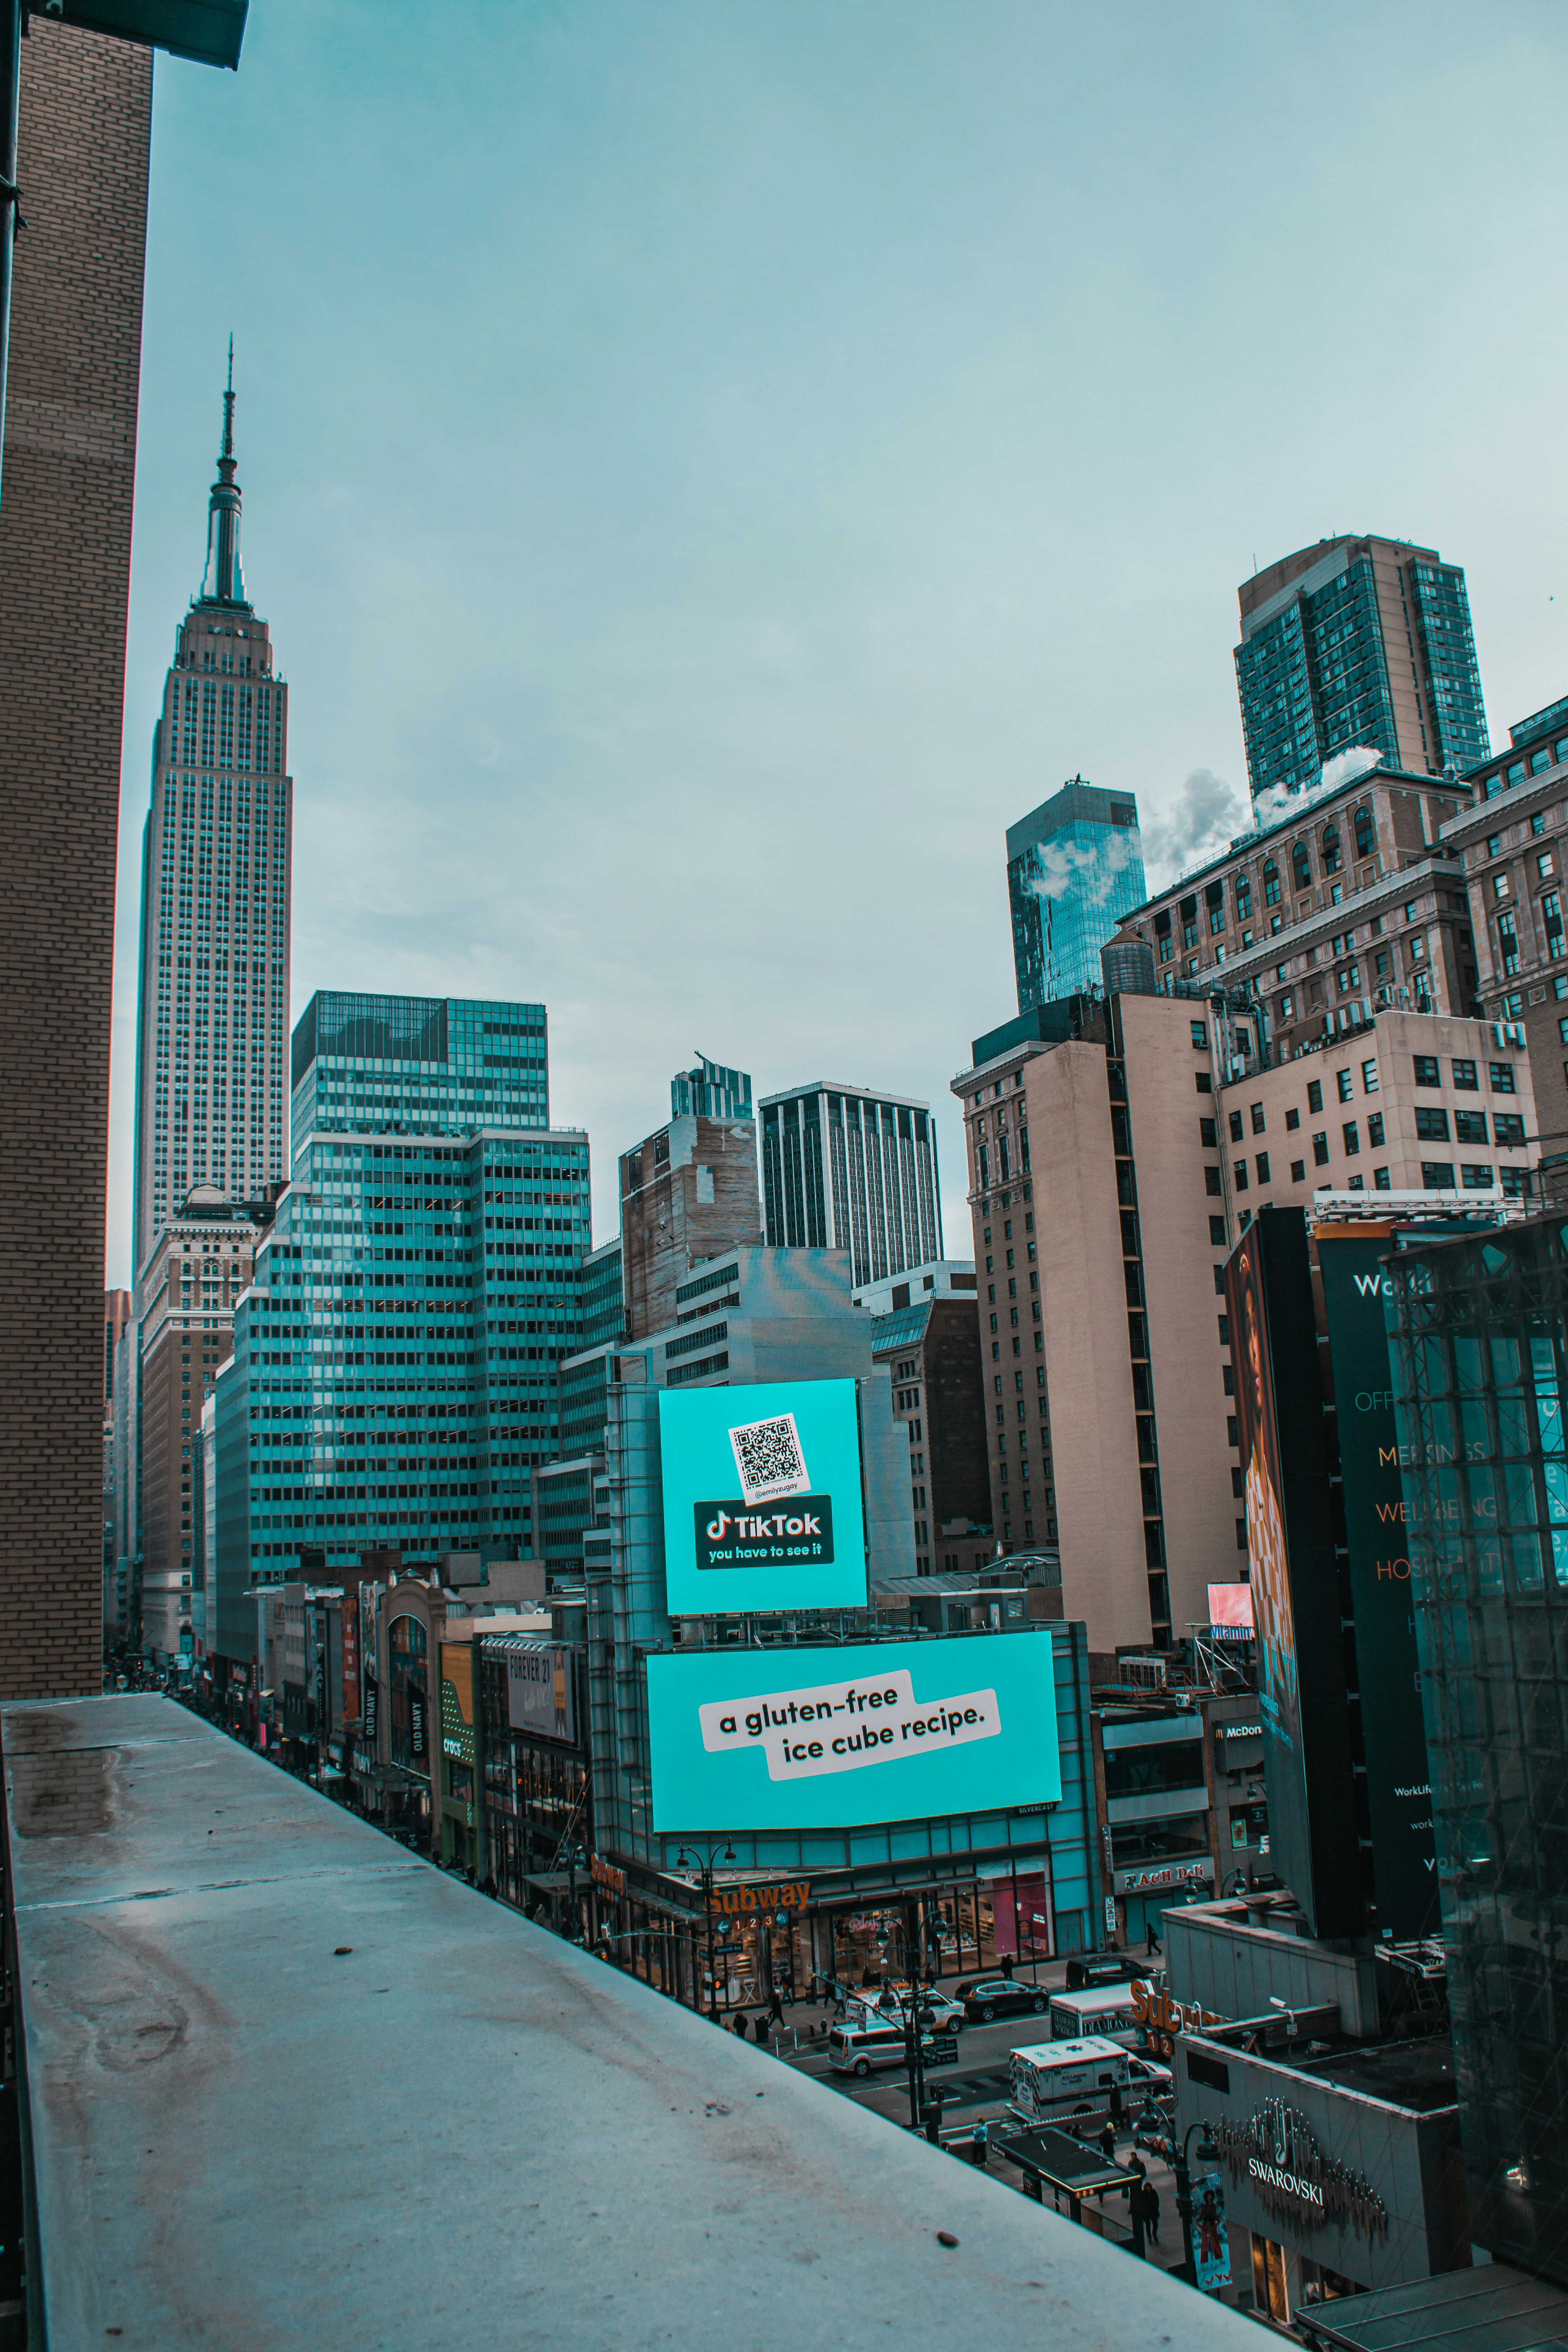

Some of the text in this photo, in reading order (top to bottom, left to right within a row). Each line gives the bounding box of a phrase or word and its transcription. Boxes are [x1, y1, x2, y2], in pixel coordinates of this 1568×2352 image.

[755, 1483, 797, 1498] @emilyzugay
[1376, 1497, 1497, 1523] WELBENG
[735, 1513, 821, 1538] TikTok
[709, 1543, 822, 1563] you have to see it
[510, 1655, 550, 1684] FOREVER 21
[366, 1689, 376, 1736] OLD NAVY
[720, 1688, 898, 1737] a gluten-free
[412, 1702, 423, 1752] OLD NAVY
[782, 1706, 985, 1763] ice cube recipe.
[1226, 1726, 1262, 1739] McDon
[443, 1737, 462, 1757] crocs
[1019, 1804, 1053, 1813] SILVERCAST
[591, 1852, 627, 1896] Subway
[1139, 1863, 1203, 1886] A&H Deli
[704, 1881, 811, 1914] Subway
[735, 1920, 740, 1929] 1
[750, 1918, 757, 1927] 2
[765, 1916, 772, 1925] 3
[1054, 2012, 1076, 2028] DIAMOND
[1150, 2035, 1155, 2048] 1
[1163, 2040, 1169, 2054] 2
[1249, 2158, 1323, 2207] SWAROVSKI
